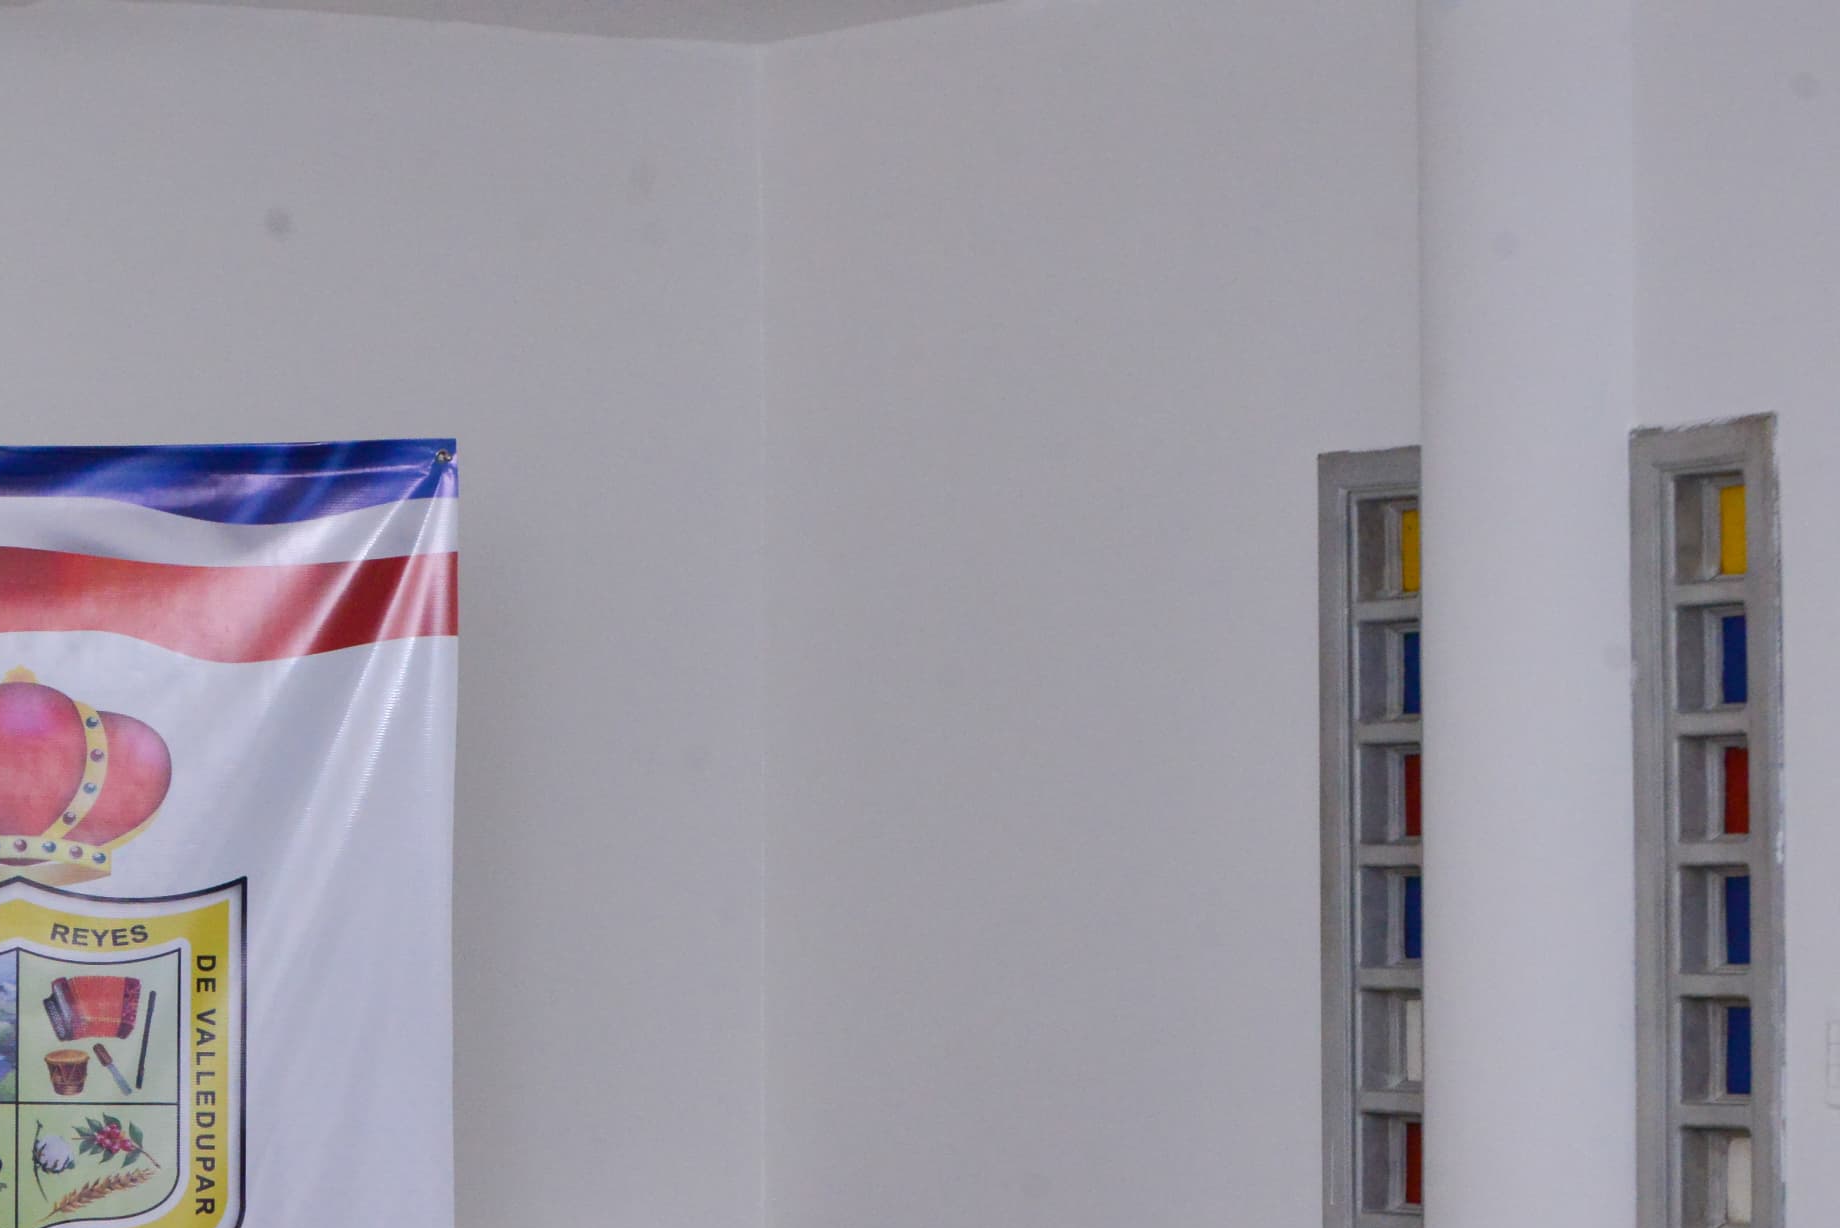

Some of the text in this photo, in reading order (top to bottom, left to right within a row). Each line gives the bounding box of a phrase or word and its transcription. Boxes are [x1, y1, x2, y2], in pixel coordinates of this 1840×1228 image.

[50, 922, 150, 948] REYES
[195, 954, 217, 1216] DE VALLEDUPAR
